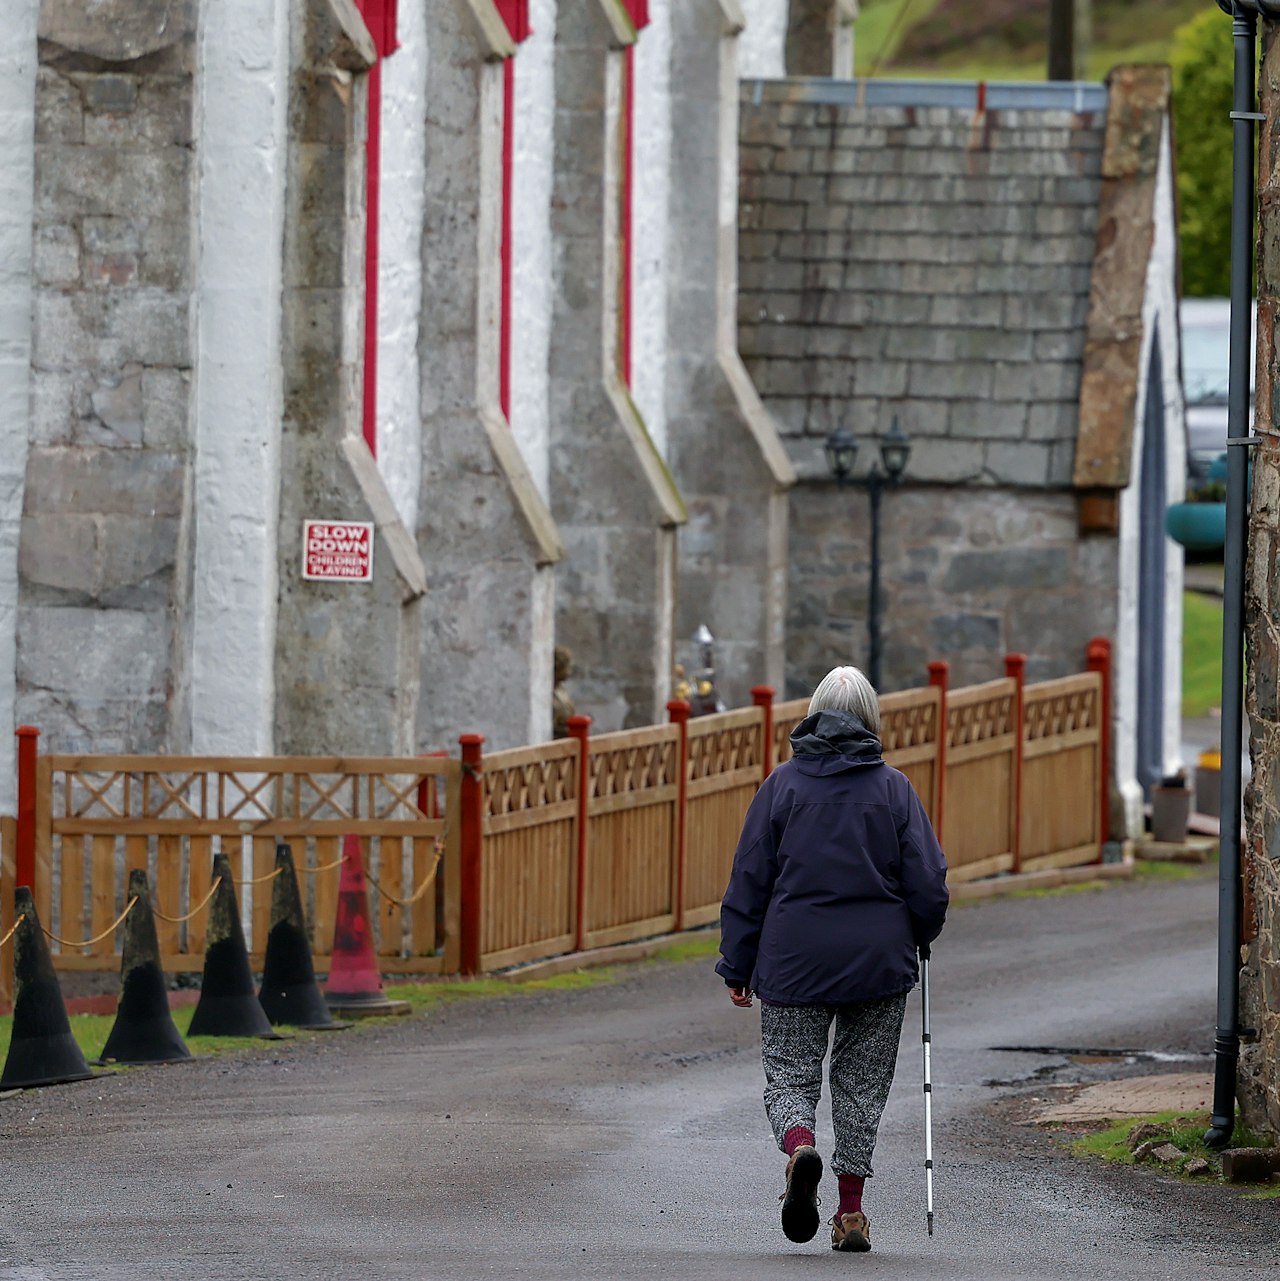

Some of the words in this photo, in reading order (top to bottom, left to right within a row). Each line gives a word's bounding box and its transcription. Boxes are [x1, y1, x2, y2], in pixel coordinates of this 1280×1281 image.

[313, 526, 364, 539] SLOW
[309, 538, 368, 553] DOWN
[309, 555, 368, 566] CHILDREN
[313, 566, 364, 576] PLAYING
